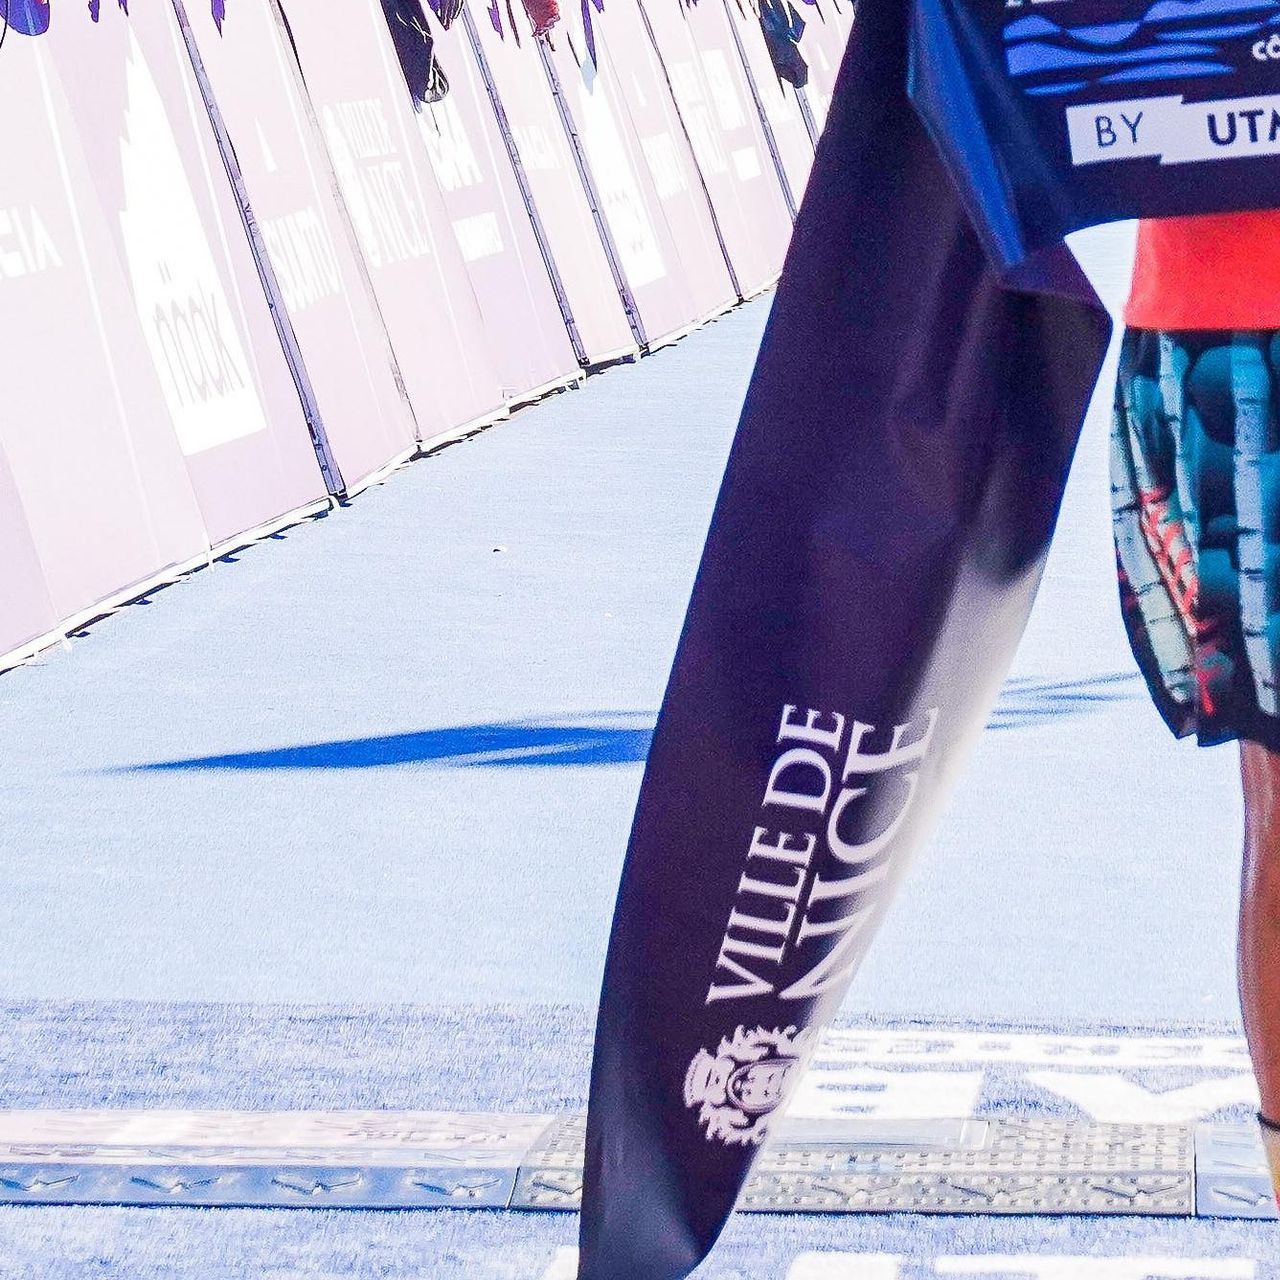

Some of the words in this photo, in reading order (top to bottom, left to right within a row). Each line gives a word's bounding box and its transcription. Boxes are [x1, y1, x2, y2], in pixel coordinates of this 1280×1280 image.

[1094, 111, 1145, 150] BY
[705, 825, 817, 1005] VILLE
[761, 704, 846, 814] DE
[779, 706, 939, 1003] NICE
